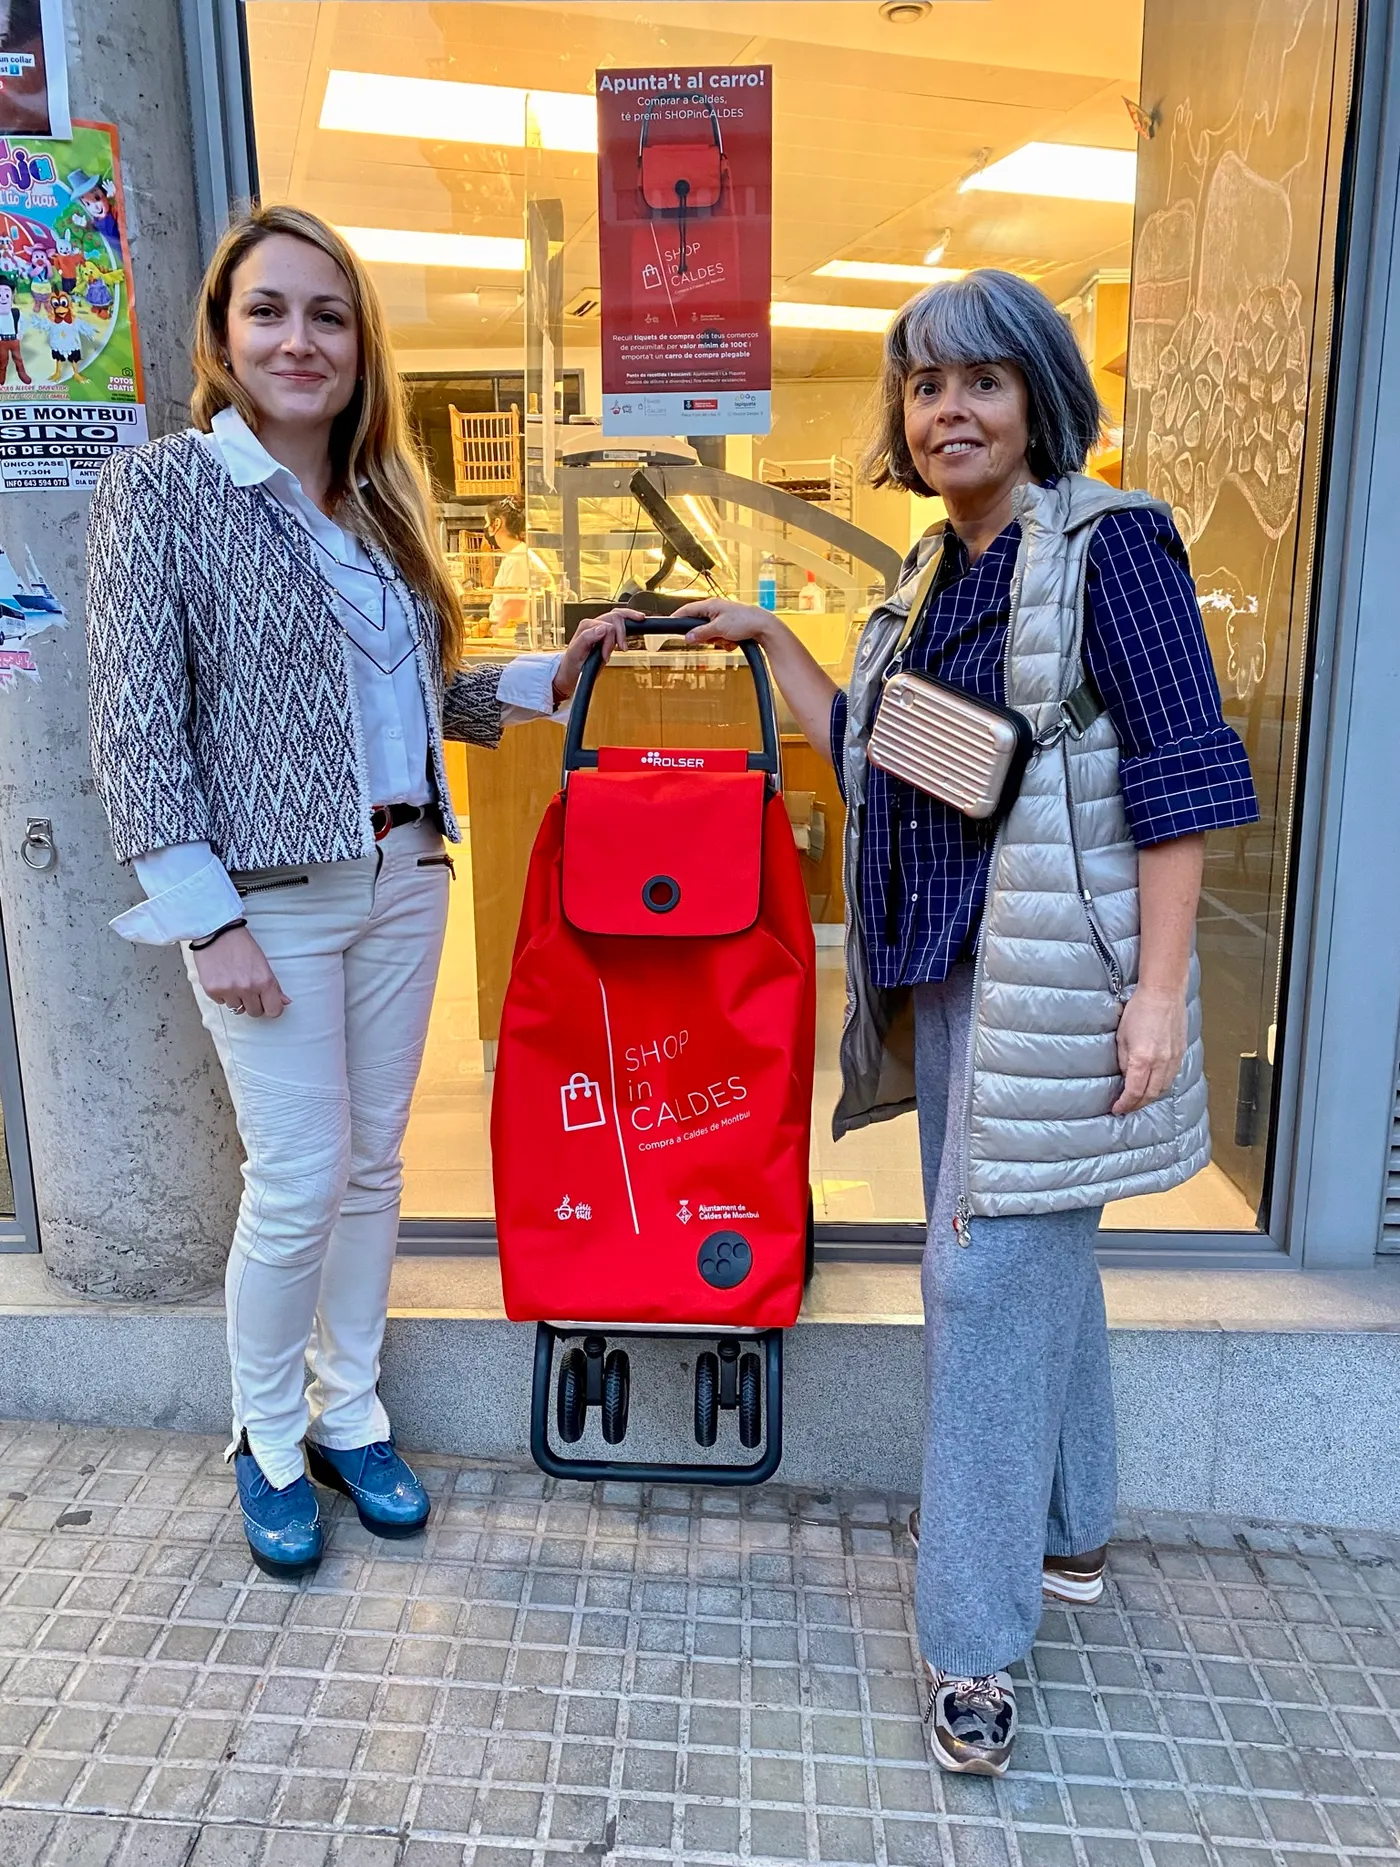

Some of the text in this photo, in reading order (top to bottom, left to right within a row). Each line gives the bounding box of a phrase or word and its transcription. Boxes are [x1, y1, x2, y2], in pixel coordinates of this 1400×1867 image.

[599, 70, 764, 94] Apunta't al carro!
[637, 96, 680, 107] Comprar
[692, 95, 727, 104] Caldes,
[621, 108, 744, 122] té premi SHOPinCALDES
[25, 190, 58, 209] Juan
[664, 242, 700, 262] SHOP
[668, 264, 679, 274] in
[671, 262, 724, 286] CALDES
[721, 350, 751, 358] plegable
[2, 408, 134, 422] DE MONTBUI
[0, 426, 115, 440] SINO
[22, 446, 44, 455] DE
[48, 445, 130, 455] OCTUBR
[652, 758, 704, 768] ROLSER
[624, 1029, 689, 1072] SHOP
[628, 1079, 653, 1102] in
[630, 1076, 748, 1132] CALDES
[638, 1138, 674, 1152] Compra
[683, 1127, 708, 1140] Caldes
[710, 1123, 720, 1132] de
[721, 1110, 751, 1127] Montbui
[699, 1204, 737, 1213] Ajuntament
[699, 1211, 760, 1220] Caldes de Montbui
